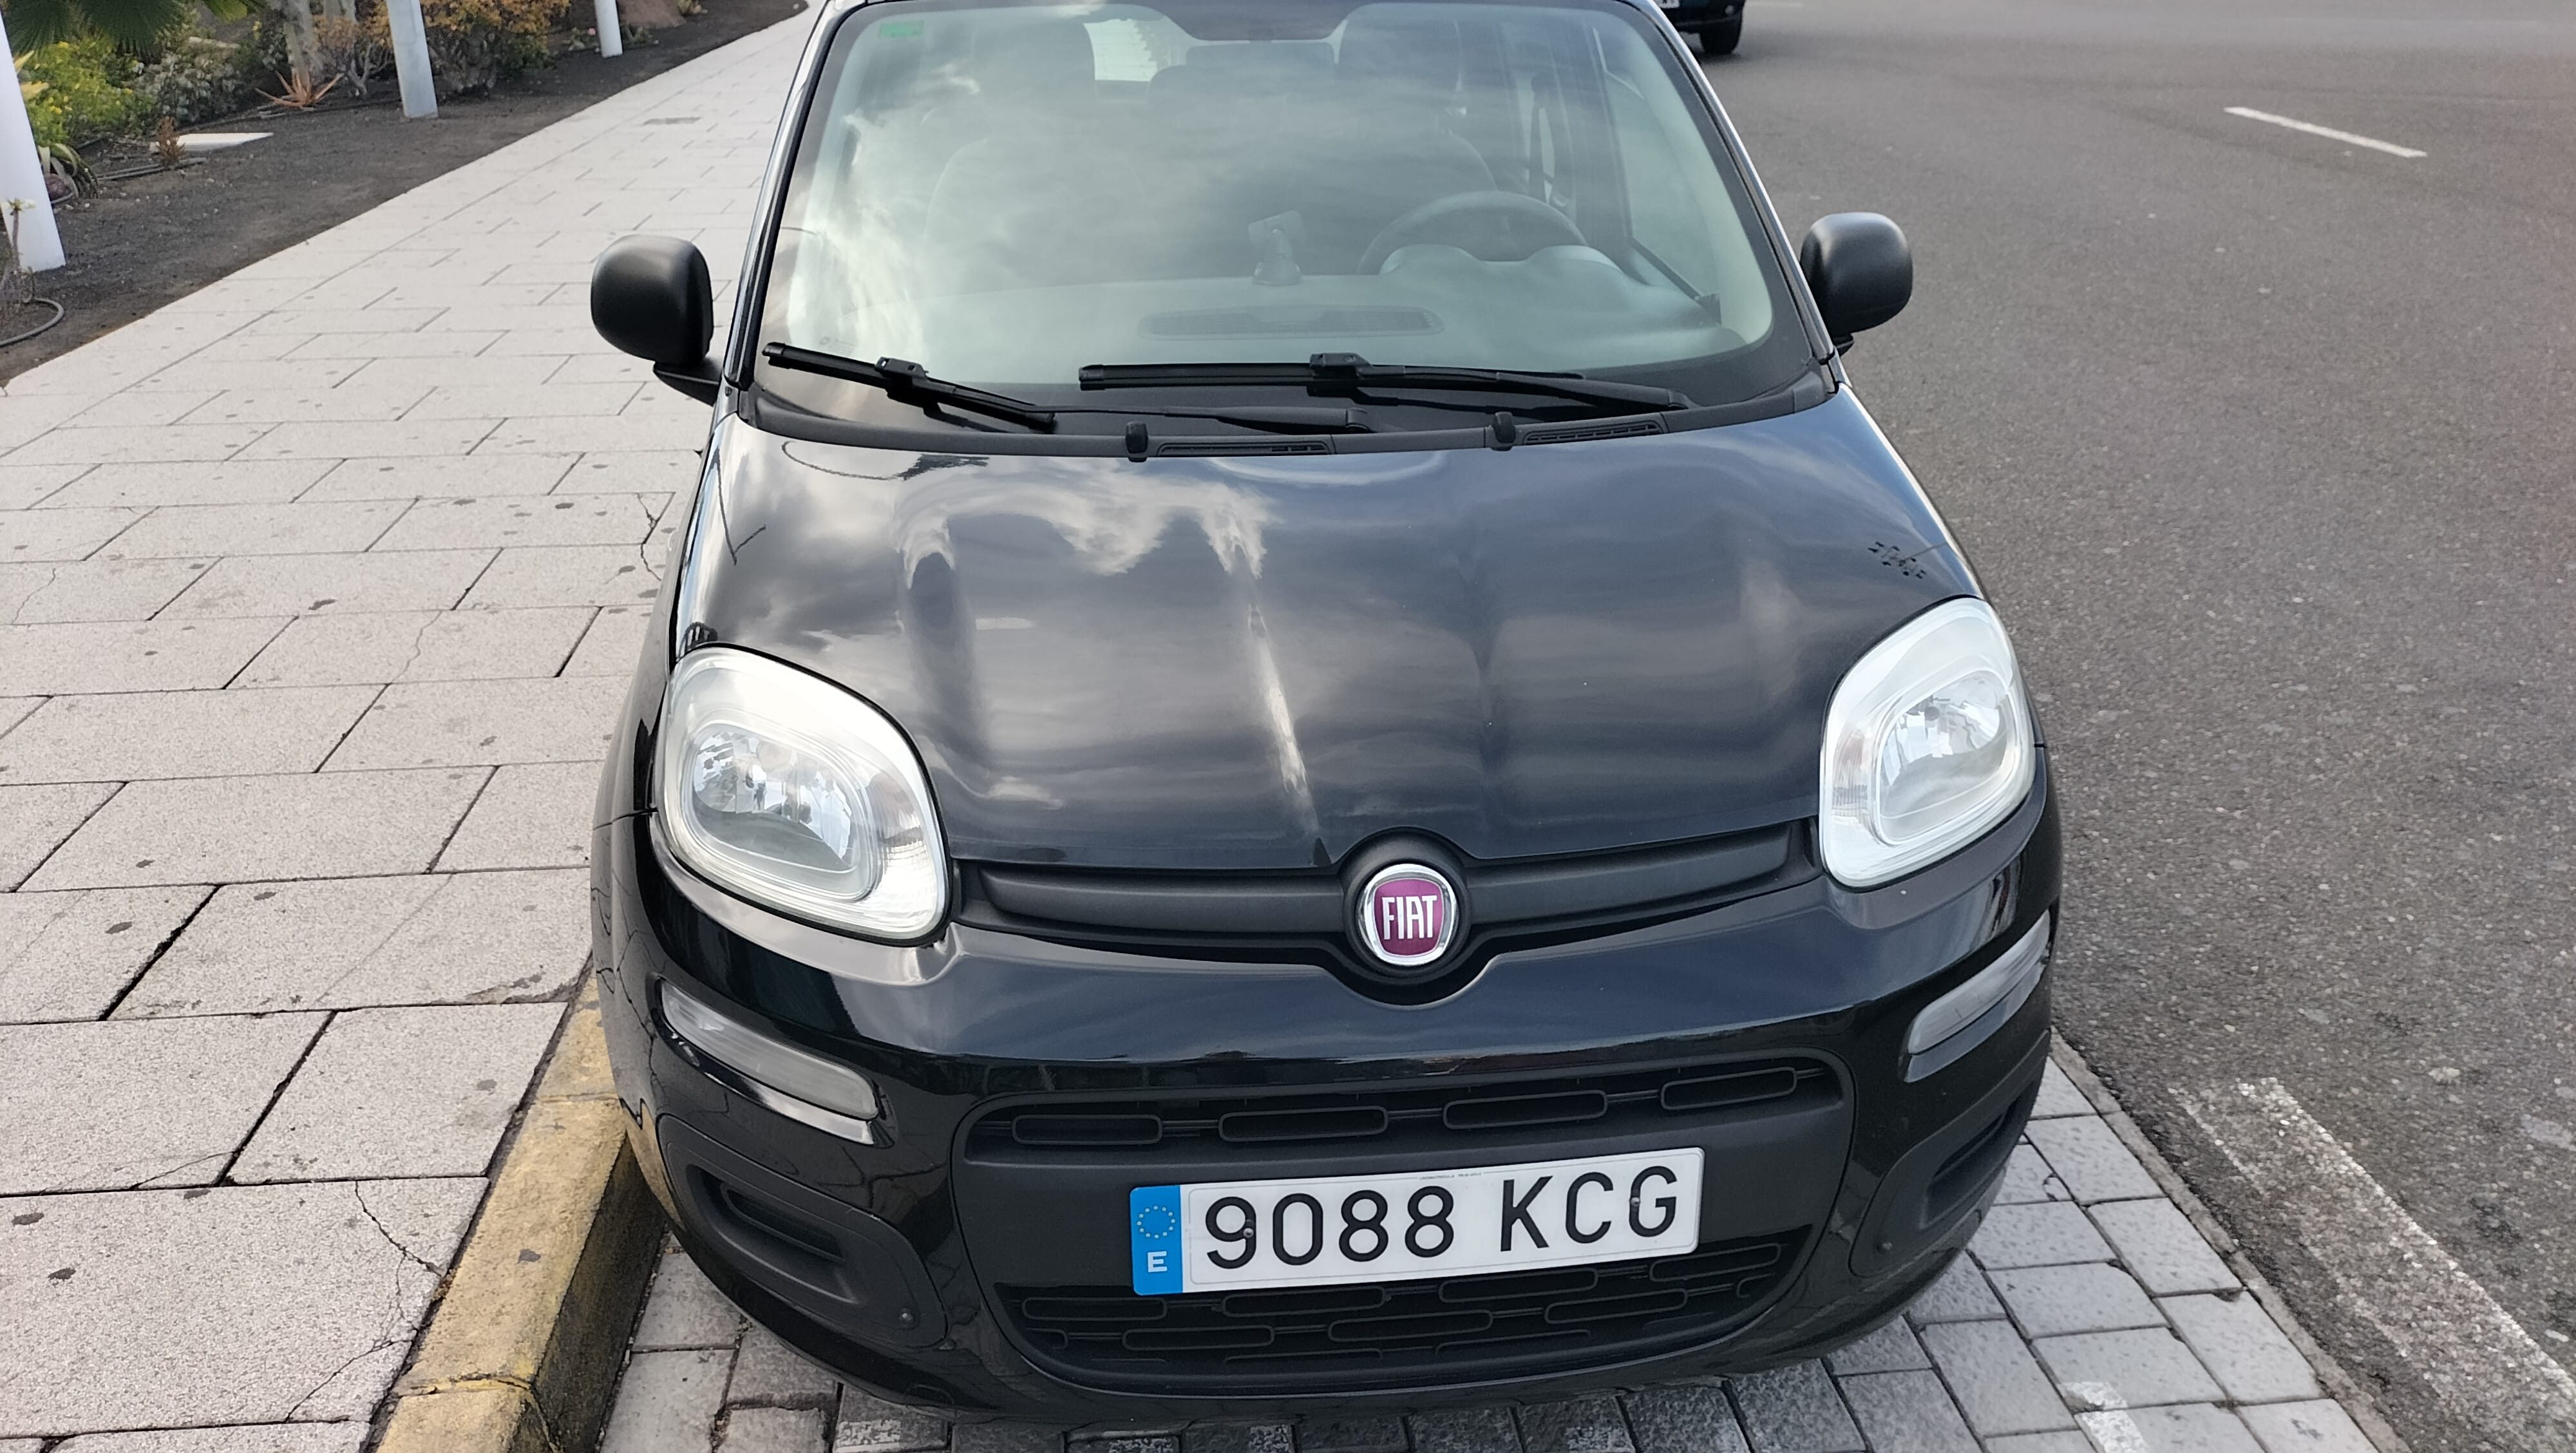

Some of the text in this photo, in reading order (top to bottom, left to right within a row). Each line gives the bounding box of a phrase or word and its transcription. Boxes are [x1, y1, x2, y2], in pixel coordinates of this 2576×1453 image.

[1381, 895, 1437, 940] FIAT
[1205, 1165, 1678, 1269] 9088 KCG
[1147, 1251, 1168, 1273] E
